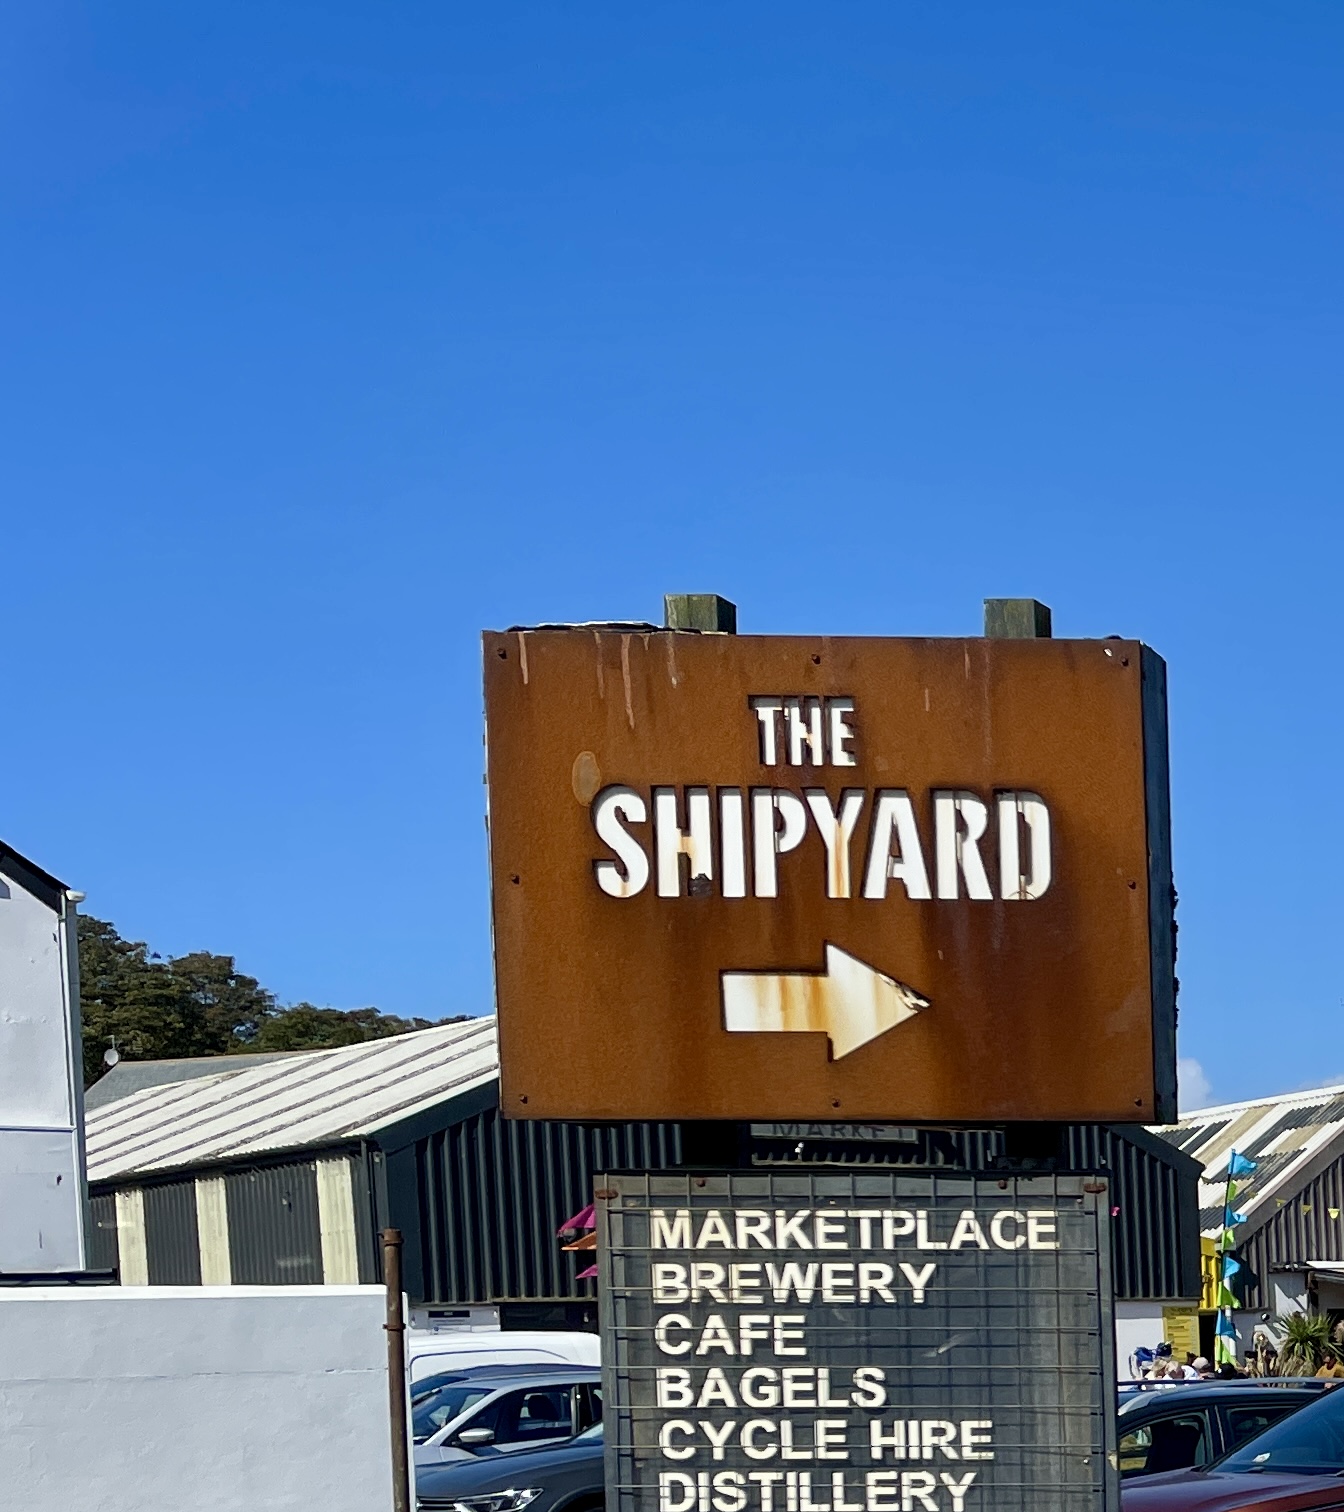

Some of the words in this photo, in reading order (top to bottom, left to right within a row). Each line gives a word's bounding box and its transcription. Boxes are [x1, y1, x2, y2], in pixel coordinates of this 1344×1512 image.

[750, 696, 857, 766] THE
[592, 784, 1052, 900] SHIPYARD
[649, 1208, 1060, 1251] MARKETPLACE
[652, 1262, 937, 1305] BREWERY
[653, 1314, 808, 1357] CAFE
[655, 1367, 888, 1409] BAGELS
[658, 1419, 850, 1461] CYCLE
[869, 1419, 996, 1461] HIRE
